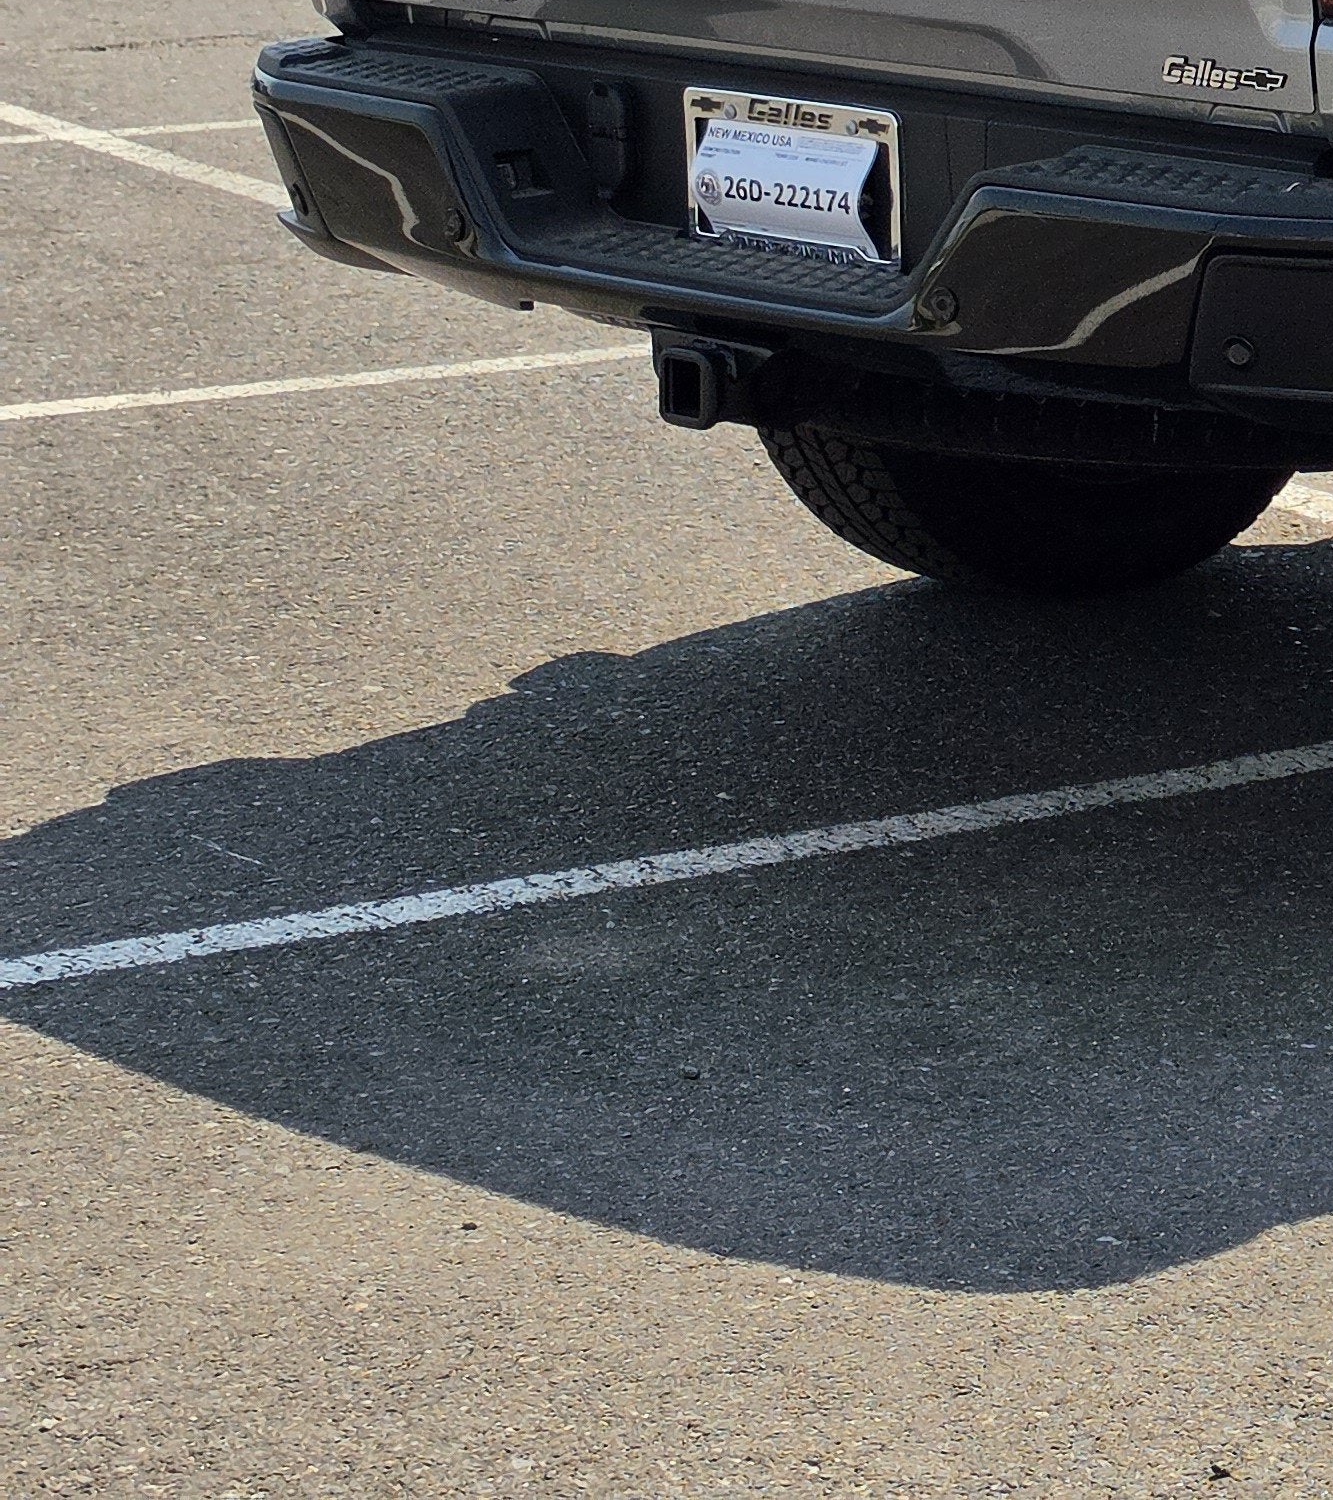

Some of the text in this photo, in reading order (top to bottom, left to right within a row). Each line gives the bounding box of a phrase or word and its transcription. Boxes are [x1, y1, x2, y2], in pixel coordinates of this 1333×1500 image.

[1162, 54, 1243, 91] Galles
[747, 97, 834, 130] Galles
[707, 126, 732, 139] NEW
[732, 129, 771, 145] MEXICO
[772, 134, 793, 148] USA
[723, 175, 851, 215] 26D-222174
